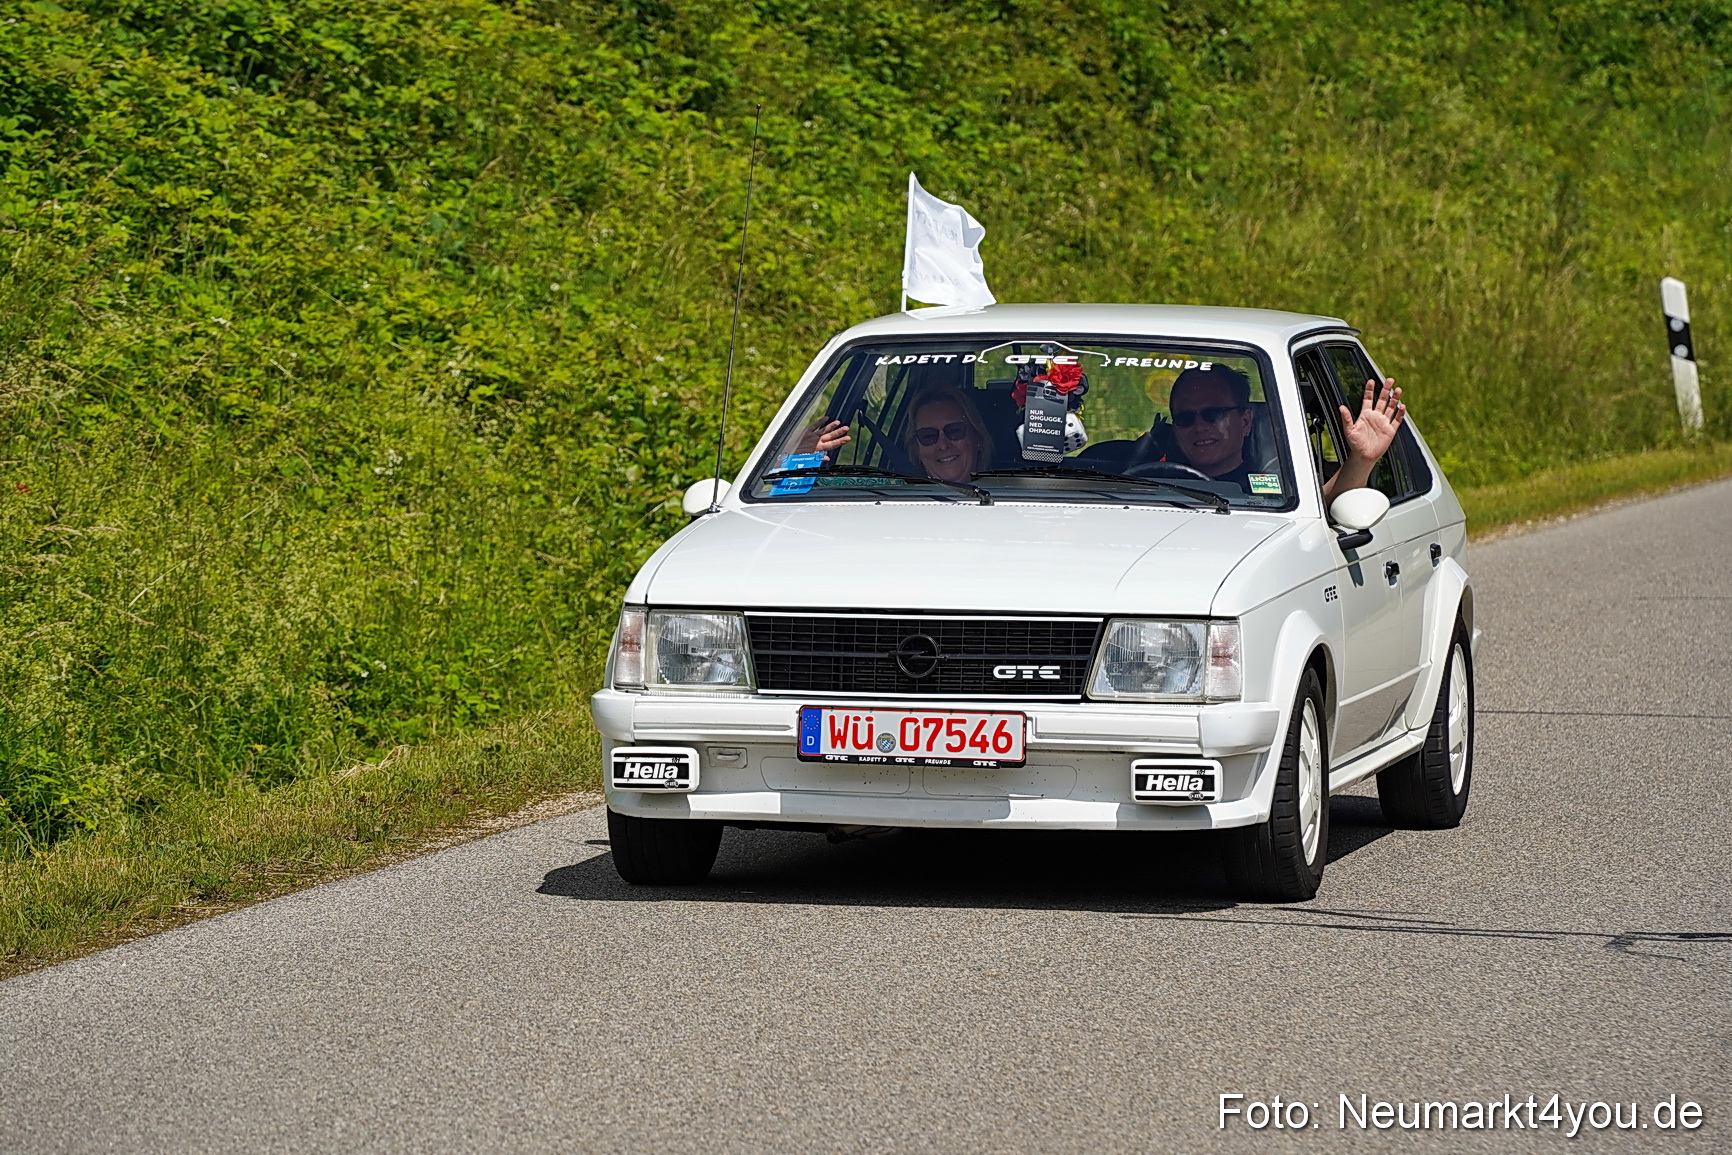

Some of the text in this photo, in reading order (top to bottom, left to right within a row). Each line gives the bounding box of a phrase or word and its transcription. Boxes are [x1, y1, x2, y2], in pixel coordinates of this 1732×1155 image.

[875, 354, 1213, 371] KADETT D GTE FREUNDE
[1029, 415, 1063, 423] OHGUGGE,
[1324, 585, 1338, 603] GTE
[993, 665, 1061, 680] GTE
[806, 735, 815, 746] D
[829, 714, 1013, 754] WÜ 07546
[825, 754, 849, 762] GTE
[623, 762, 679, 779] Hella
[1145, 774, 1204, 791] Hella
